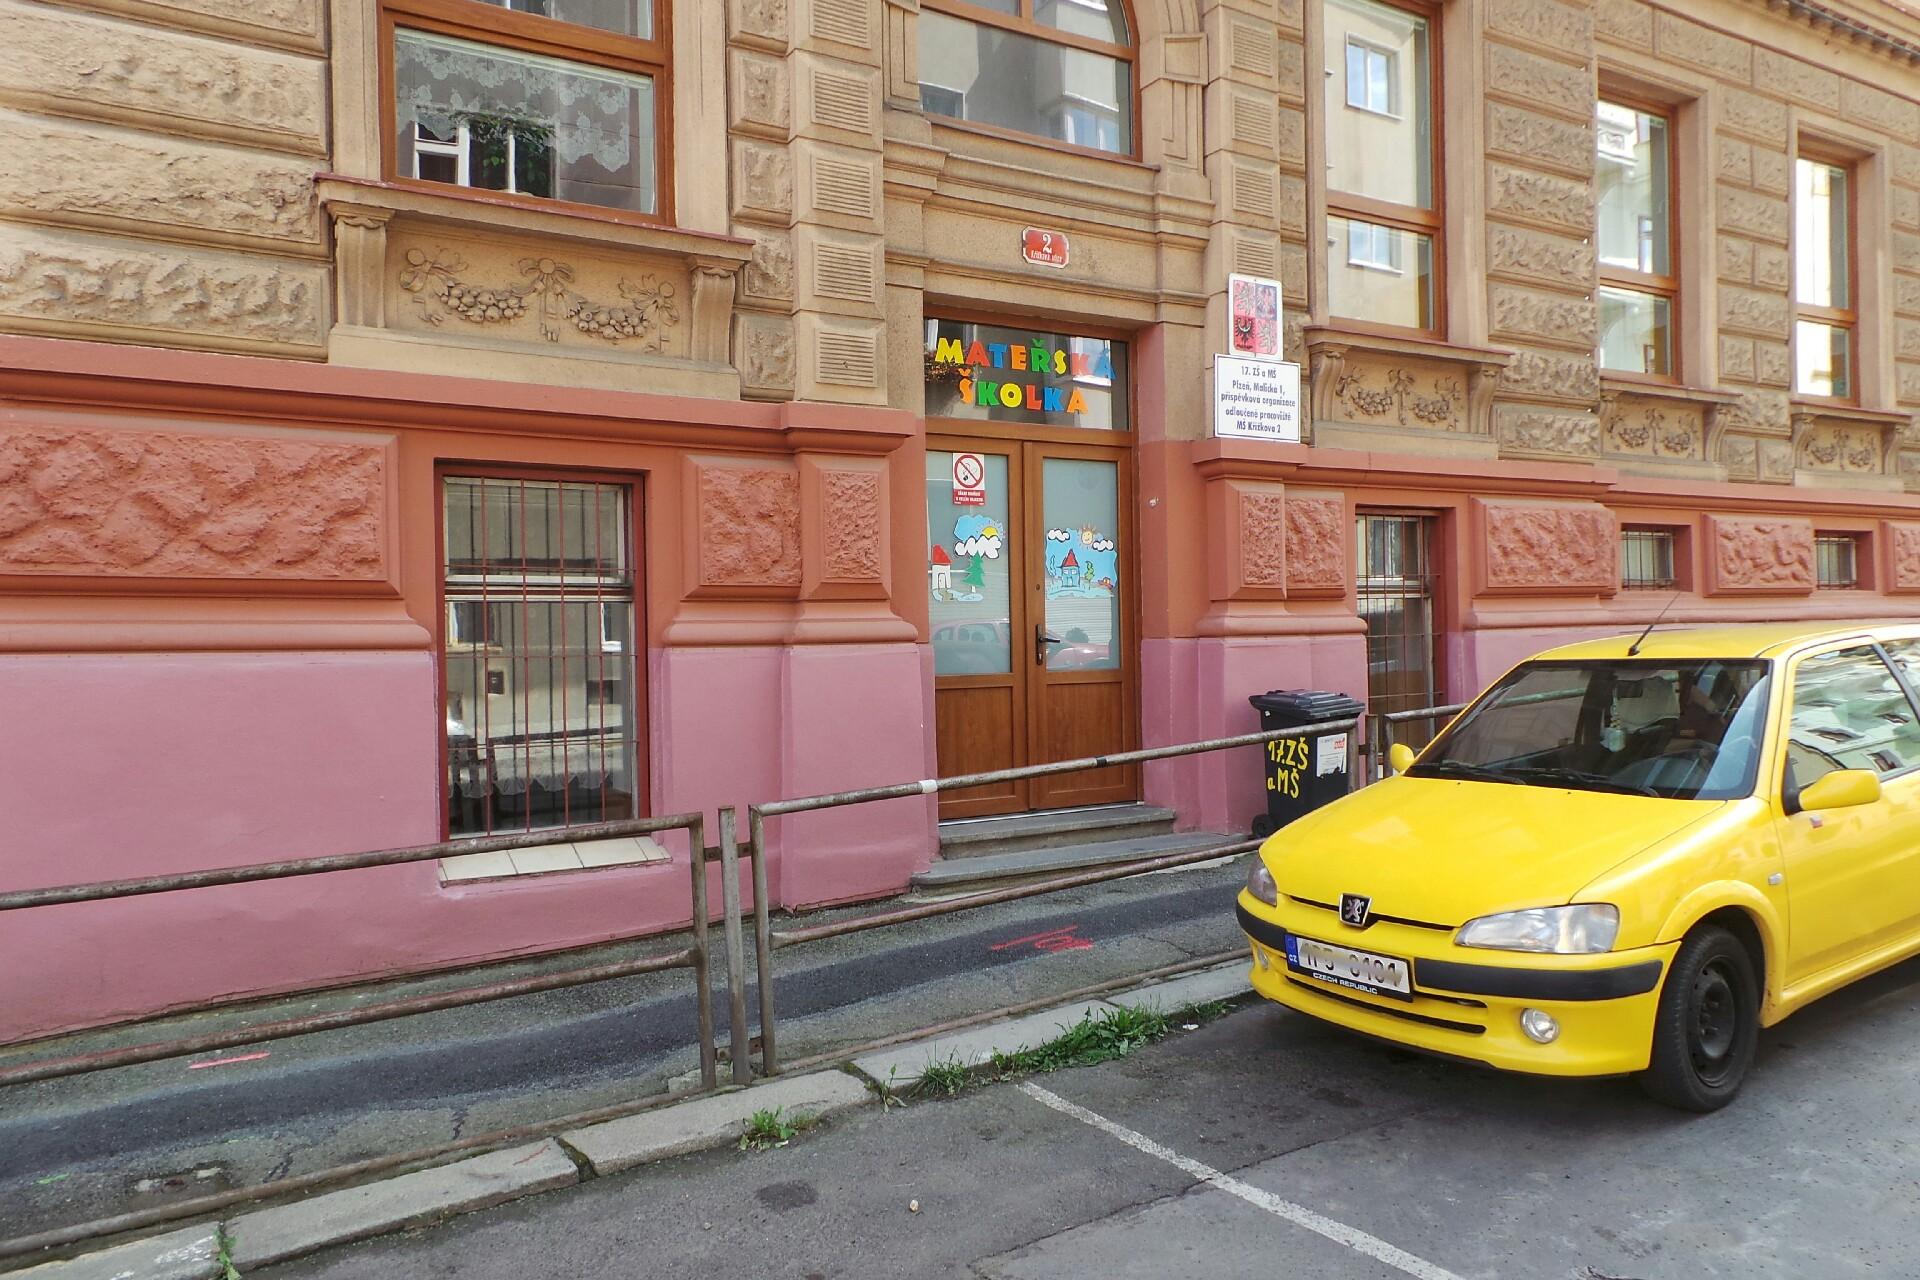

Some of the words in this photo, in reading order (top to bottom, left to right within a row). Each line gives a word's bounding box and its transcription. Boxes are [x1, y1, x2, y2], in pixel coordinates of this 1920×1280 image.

[1042, 233, 1052, 254] 2
[935, 337, 1116, 380] MATEŘSKÁ
[1241, 365, 1251, 376] 17.
[1252, 365, 1260, 377] ZŠ
[1261, 370, 1266, 378] a
[1267, 367, 1277, 379] MŠ
[959, 368, 1089, 414] ŠKOLKA
[1232, 380, 1252, 392] Plzeň,
[1262, 396, 1296, 408] organizace
[1259, 410, 1292, 422] pracoviště
[1236, 418, 1246, 430] MŠ
[1276, 424, 1281, 433] 2
[1267, 777, 1276, 790] a
[1277, 767, 1300, 798] MŠ
[1288, 954, 1298, 963] CZ
[1312, 972, 1338, 984] CZECH
[1339, 979, 1378, 995] REPUBLIC
